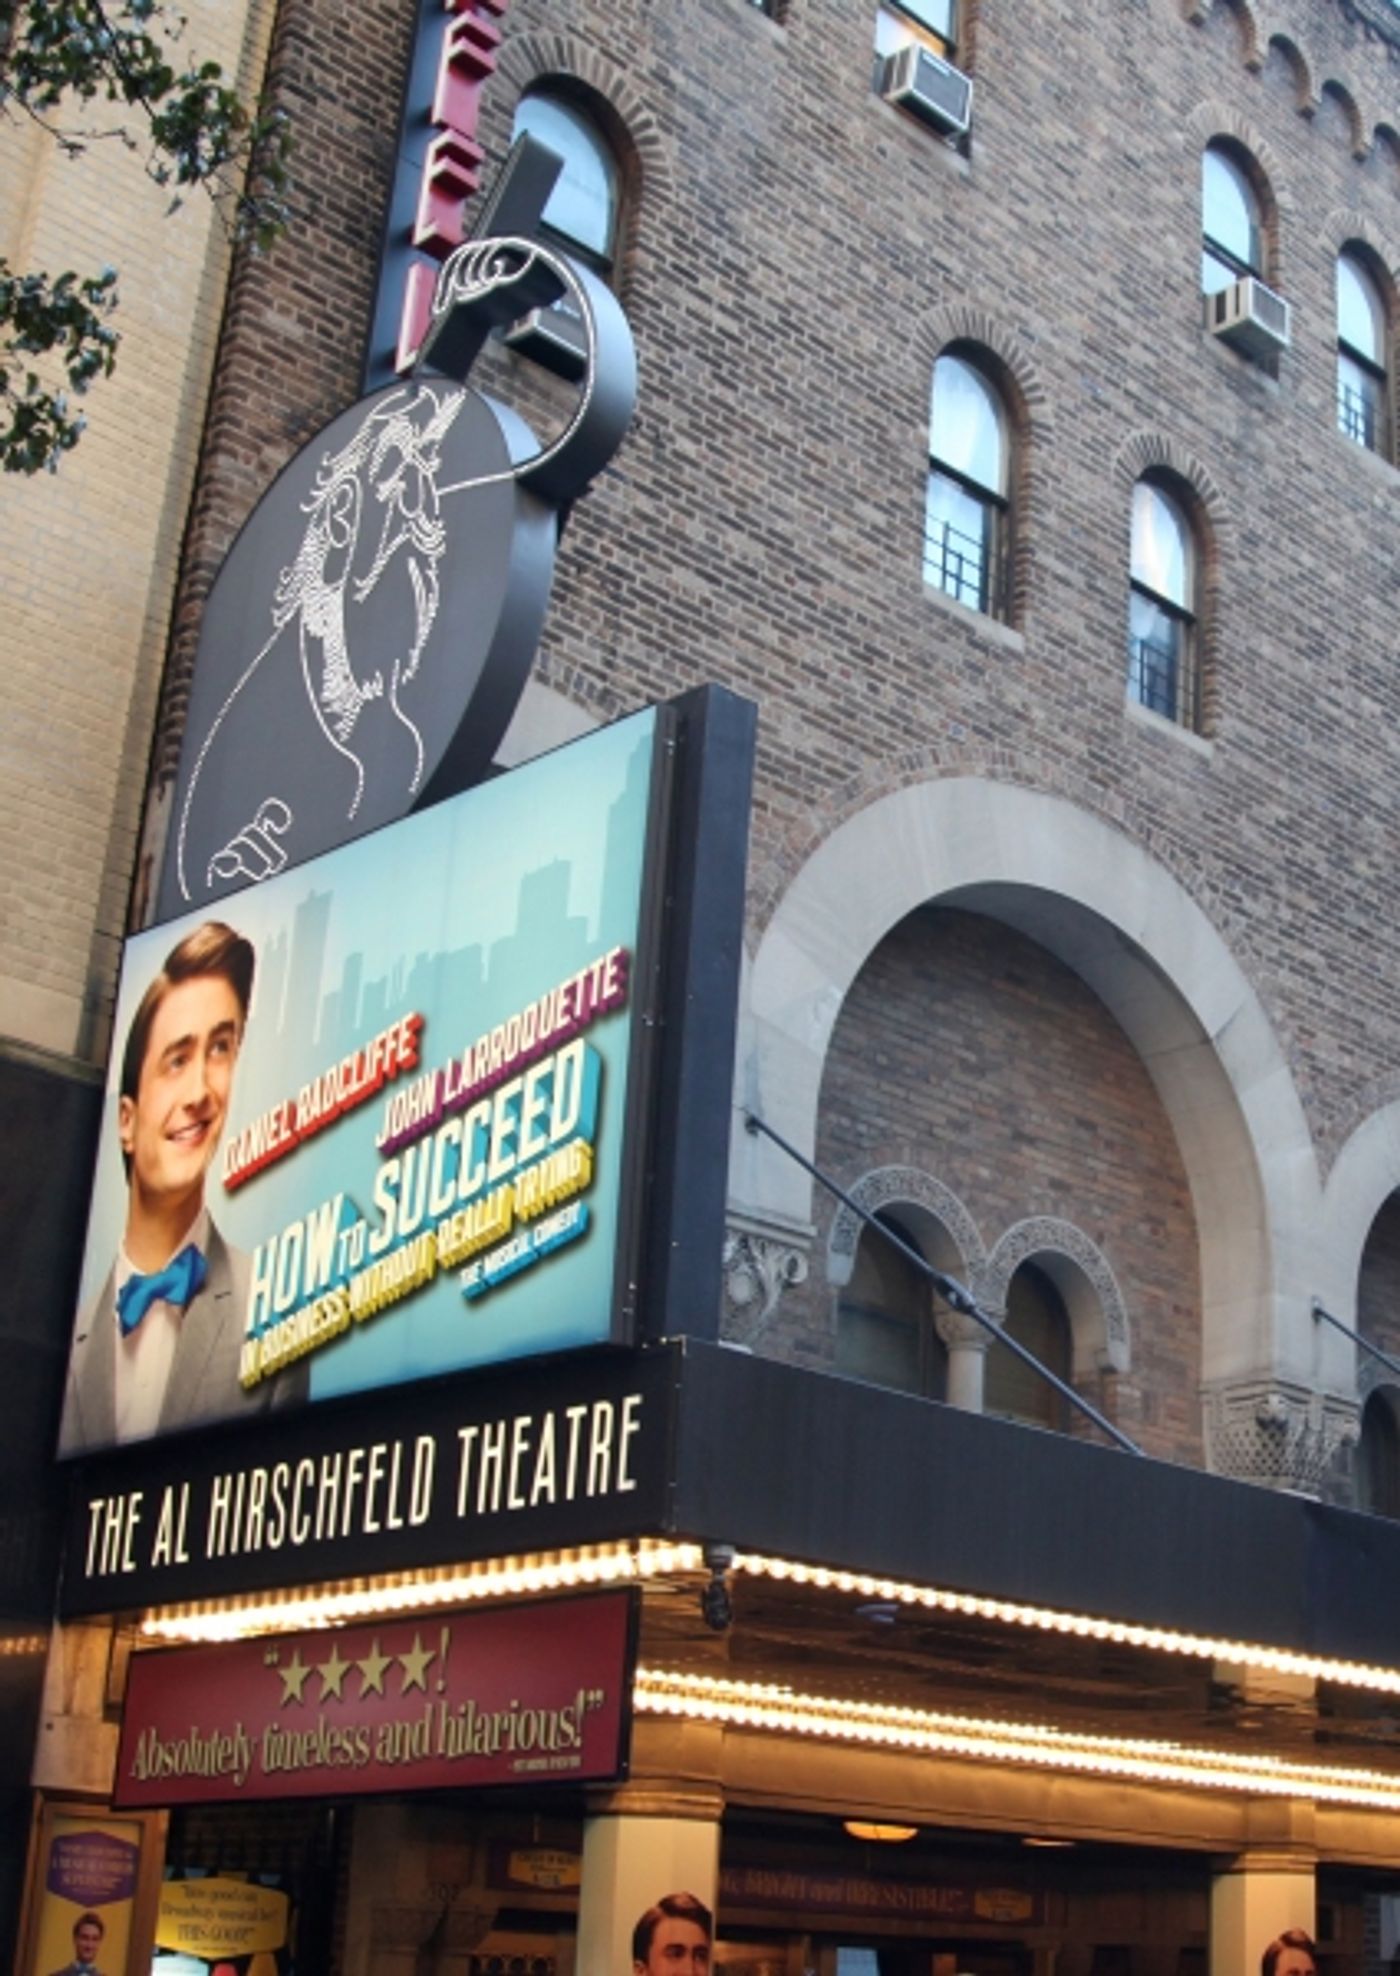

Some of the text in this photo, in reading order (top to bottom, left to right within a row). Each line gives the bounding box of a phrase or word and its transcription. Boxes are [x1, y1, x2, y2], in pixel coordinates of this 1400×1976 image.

[222, 1011, 421, 1186] DANIEL RADCLIFFE
[376, 945, 627, 1154] JOHN LARROQUETTE
[244, 1037, 593, 1337] HOW TO SUCCEED
[260, 1284, 351, 1374] BUSINESS
[436, 1182, 515, 1267] REALLY
[514, 1137, 593, 1219] TRYING
[85, 1394, 642, 1577] THE AL HIRSCHFELD THEATRE
[129, 1721, 257, 1786] Absolutely
[262, 1714, 370, 1774] timeless
[375, 1703, 435, 1763] and
